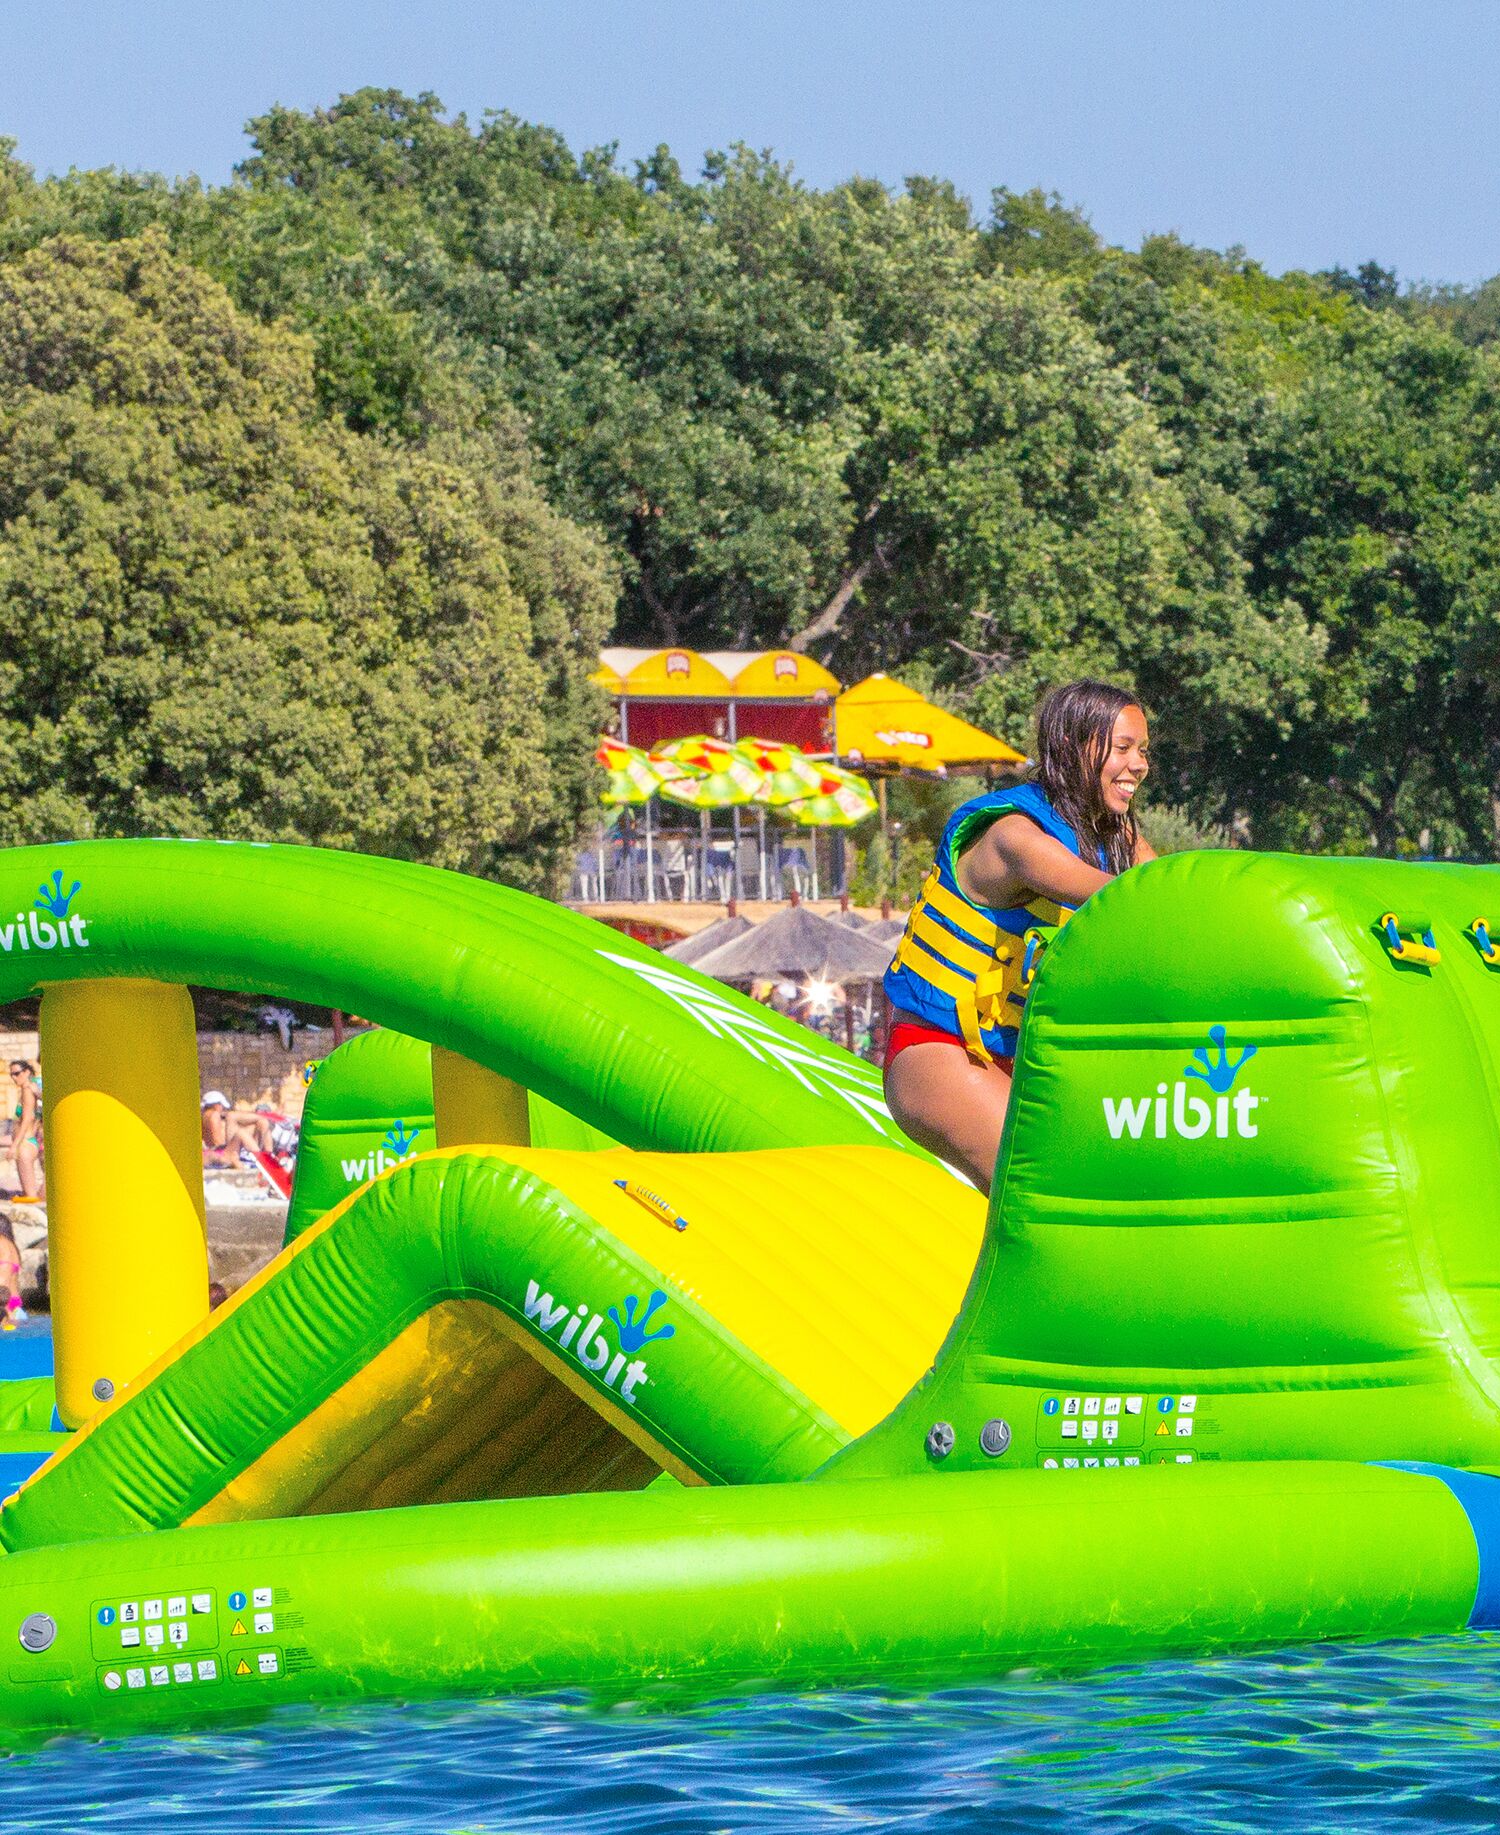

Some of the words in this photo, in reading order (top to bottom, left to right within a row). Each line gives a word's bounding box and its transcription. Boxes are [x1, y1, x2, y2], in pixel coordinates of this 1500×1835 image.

[1102, 1081, 1259, 1140] wibit
[341, 1149, 418, 1182] wib
[524, 1279, 649, 1404] wibit
